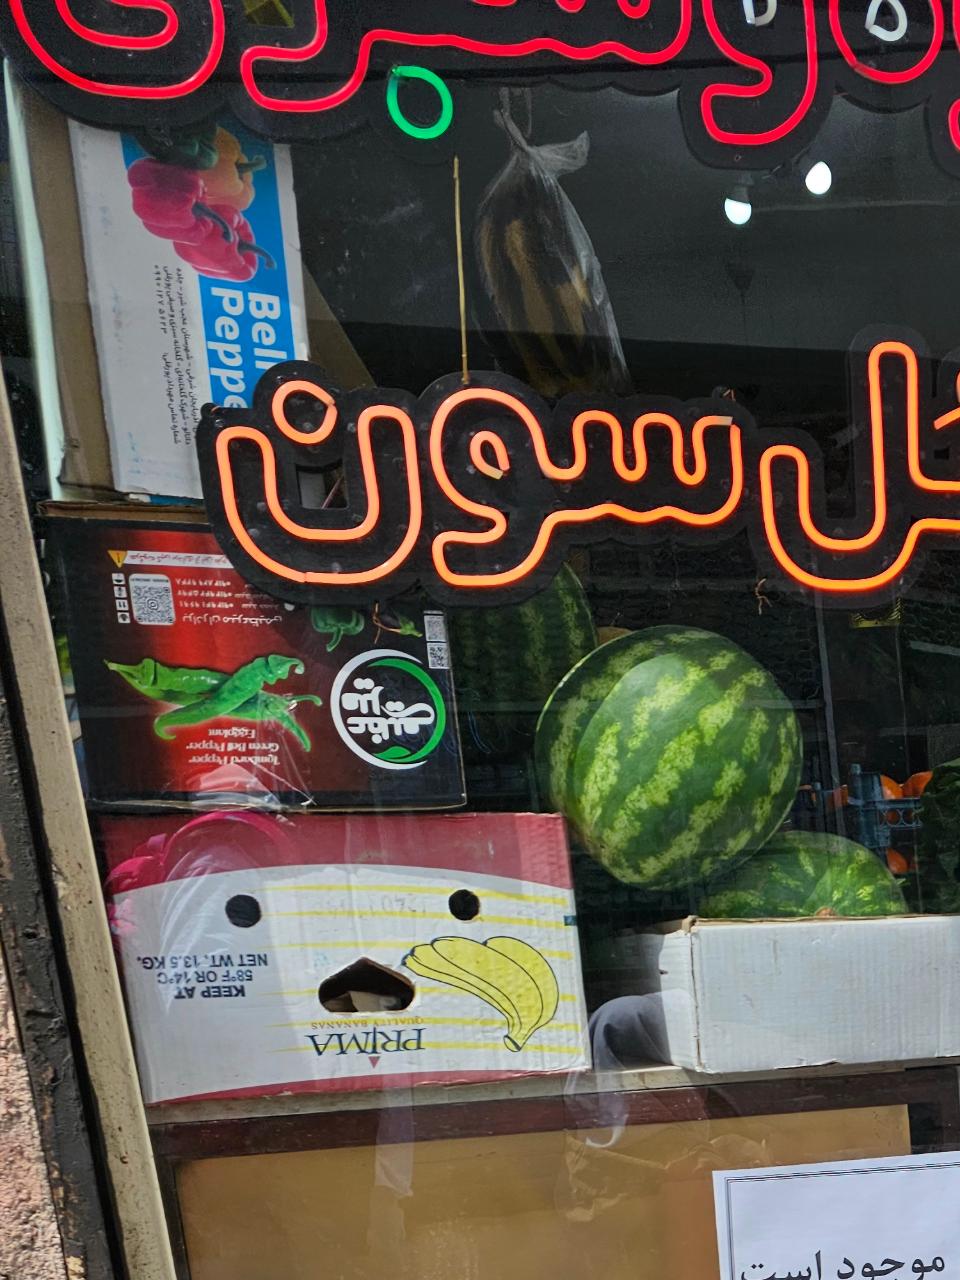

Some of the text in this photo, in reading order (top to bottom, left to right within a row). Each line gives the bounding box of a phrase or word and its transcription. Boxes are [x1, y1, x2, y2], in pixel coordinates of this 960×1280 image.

[247, 292, 287, 370] Bell
[207, 287, 250, 408] Peppe
[181, 613, 220, 624] برادران
[208, 726, 256, 739] Eggplant
[186, 740, 225, 752] Pepper
[248, 742, 280, 752] Green
[189, 753, 228, 765] Pepper
[136, 956, 166, 970] KG.
[169, 954, 200, 969] 13.5
[238, 953, 268, 968] NET
[194, 970, 217, 983] OR
[174, 984, 246, 1000] KEEP AT
[310, 1016, 424, 1030] QUALITY BANANAS
[304, 1026, 427, 1056] PRIMA
